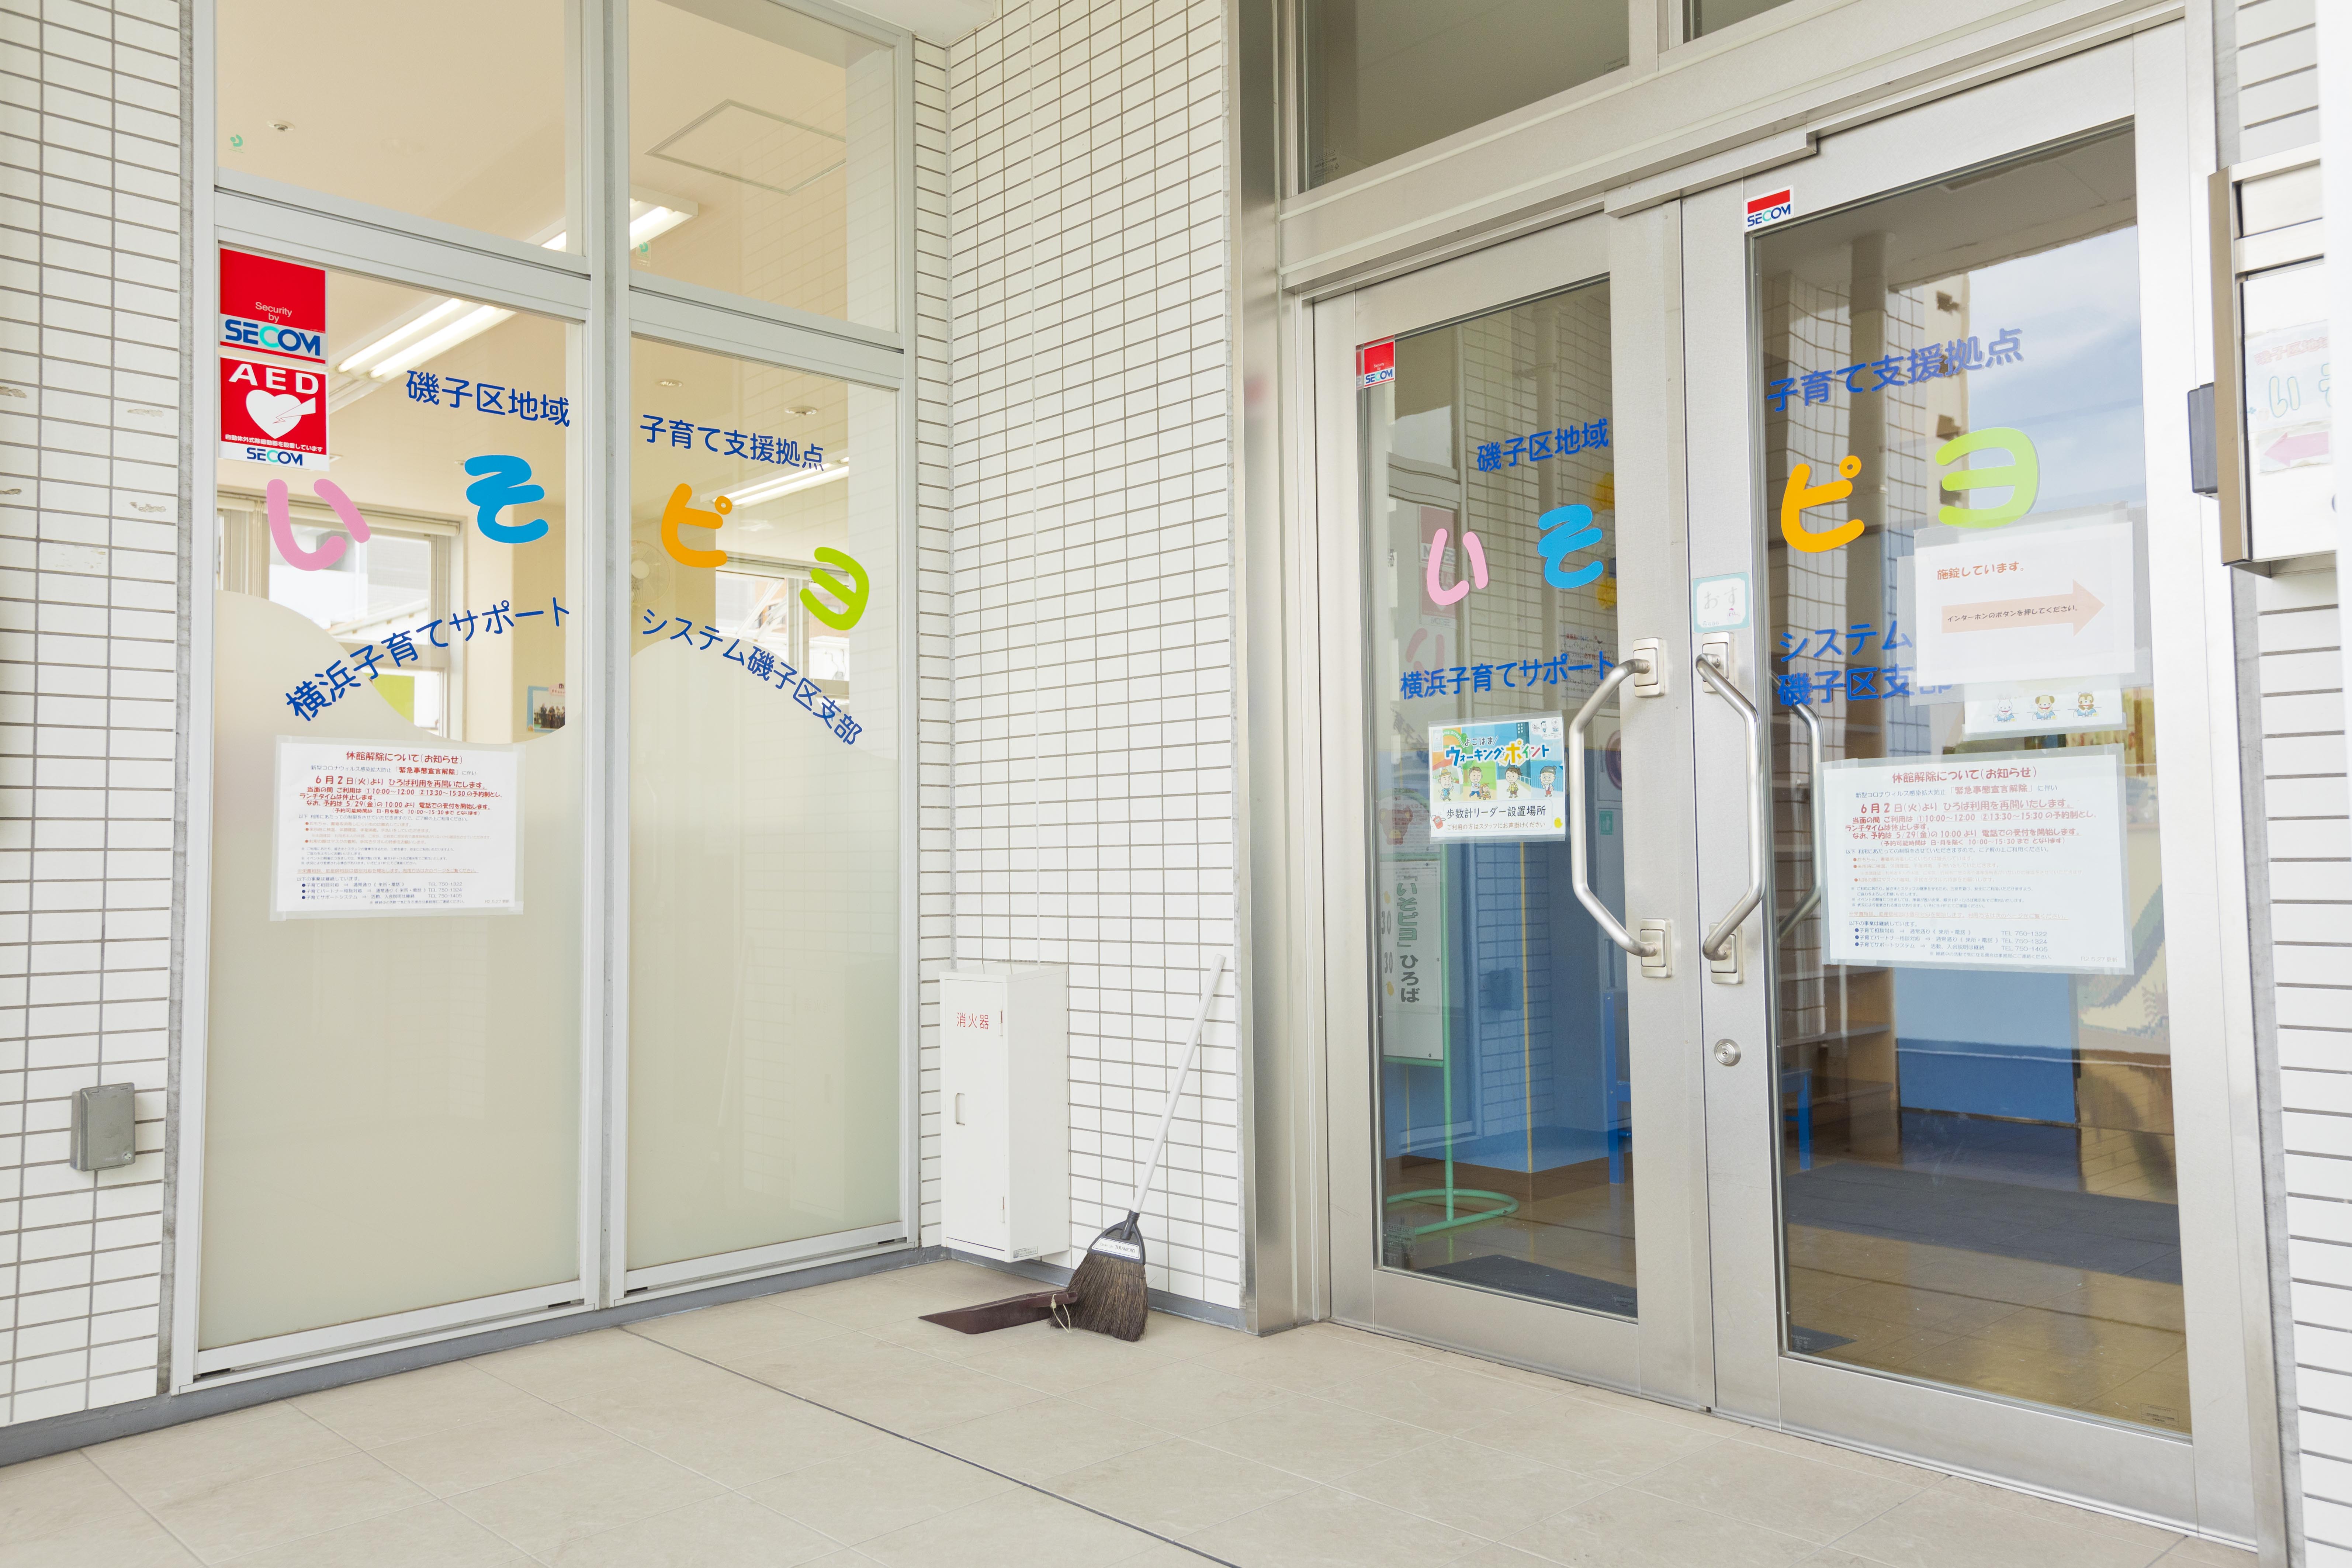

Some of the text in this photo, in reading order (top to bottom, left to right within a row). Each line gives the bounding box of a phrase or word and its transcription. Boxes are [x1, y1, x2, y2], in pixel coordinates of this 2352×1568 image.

[1747, 204, 1791, 227] SECOM
[255, 301, 292, 317] Security
[268, 313, 279, 323] by
[225, 319, 320, 356] SECOM
[229, 363, 319, 394] AED
[1366, 369, 1393, 384] SECOM
[1767, 328, 2023, 412] 子育て支援拠点
[406, 370, 824, 471] 磯子区地域 子育て支援拠点
[225, 434, 323, 452] 自動体外式除細動器を設置しています
[1476, 418, 1609, 473] 磯子区地域
[247, 447, 303, 466] SECOM
[1937, 561, 2024, 580] 施錠しています。
[1947, 605, 2078, 622] インターホンのボタンを押してください。
[1780, 620, 1913, 662] システム
[285, 597, 863, 745] 横浜子育てサポート システム磯子区支部
[1400, 651, 1614, 700] 横浜子育てサポート
[1465, 737, 1493, 747] よこはま
[346, 751, 462, 764] 休館解除について(お知らせ)
[1446, 740, 1549, 766] ウォーキングポイント
[388, 777, 485, 788] ひろば利用を再開いたします。
[1892, 766, 2036, 783] 休館解除について(お知らせ)
[1446, 805, 1546, 819] 歩数計リーダー設置場所
[1943, 796, 2071, 811] ひろば利用を再開いたします。
[1447, 821, 1545, 830] ご利用の方はスタッフにお声掛けください
[1845, 823, 1930, 832] ランチタイムは休止します。
[1884, 815, 1913, 823] ご利用は
[1981, 827, 2079, 837] 電話での受付を開始します。
[1400, 955, 1420, 1003] ひろば
[956, 1012, 990, 1030] 消火器
[1115, 1245, 1136, 1253] TERAMOTO
